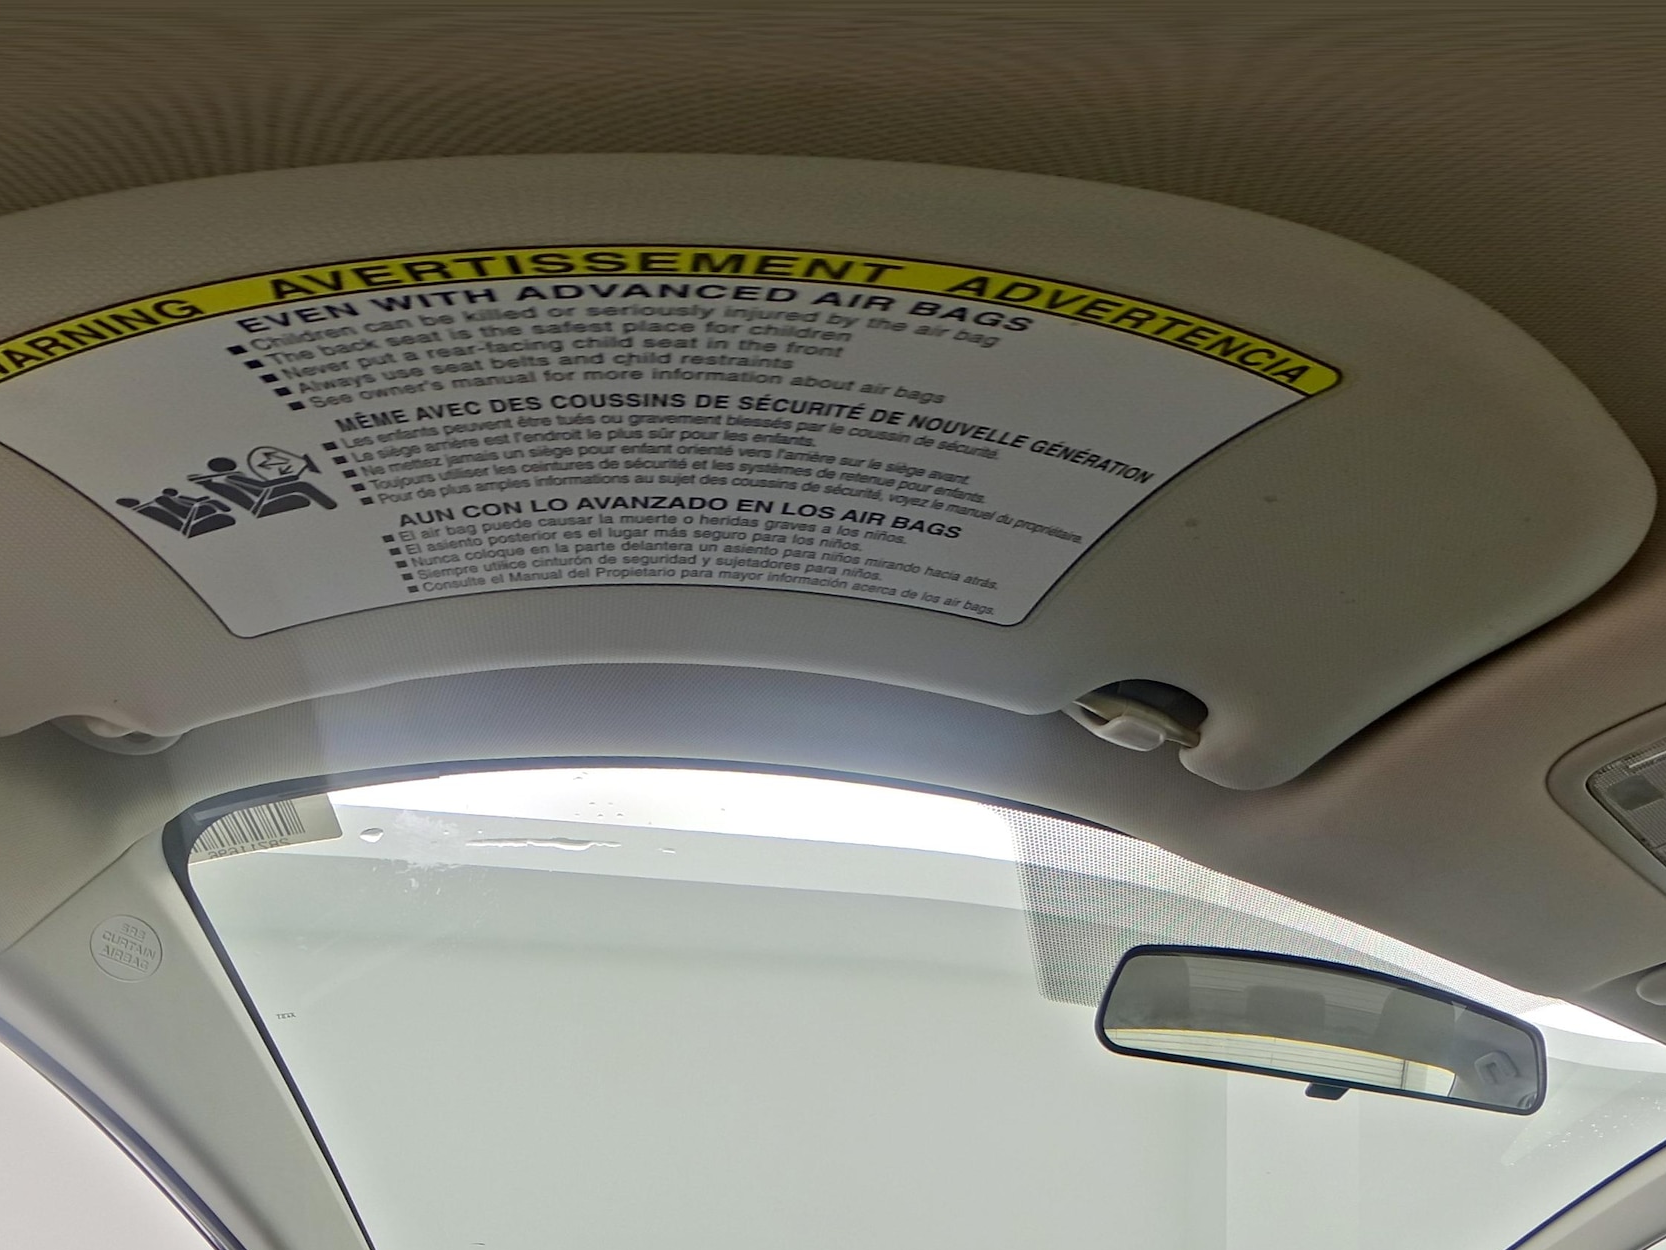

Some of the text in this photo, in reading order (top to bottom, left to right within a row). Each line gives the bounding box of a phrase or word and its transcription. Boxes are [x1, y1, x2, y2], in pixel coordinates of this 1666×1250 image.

[270, 251, 903, 299] AVERTISSEMENT
[235, 283, 1033, 333] EVEN WITH ADVANCED AIR BAGS
[249, 304, 1000, 350] Children can be killed or seriously injured by the air bag
[944, 276, 1310, 383] ADVERTENCIA
[263, 320, 852, 364] The back seat is the safest place for children
[280, 336, 843, 379] Never put a rear-facing child seat in the front
[298, 352, 793, 394] Always use seat belts and child restraints
[308, 368, 945, 408] See owner's manual for more information about air bags
[334, 393, 1154, 483] MÊME AVEC DES COUSSINS DE SÉCURITÉ DE NOUVELLE GÉNÉRATION
[397, 513, 906, 544] El air bag puede causar la muerte o heridas graves a los niños.
[400, 496, 962, 538] AUN CON LO AVANZADO EN LOS AIR BAGS
